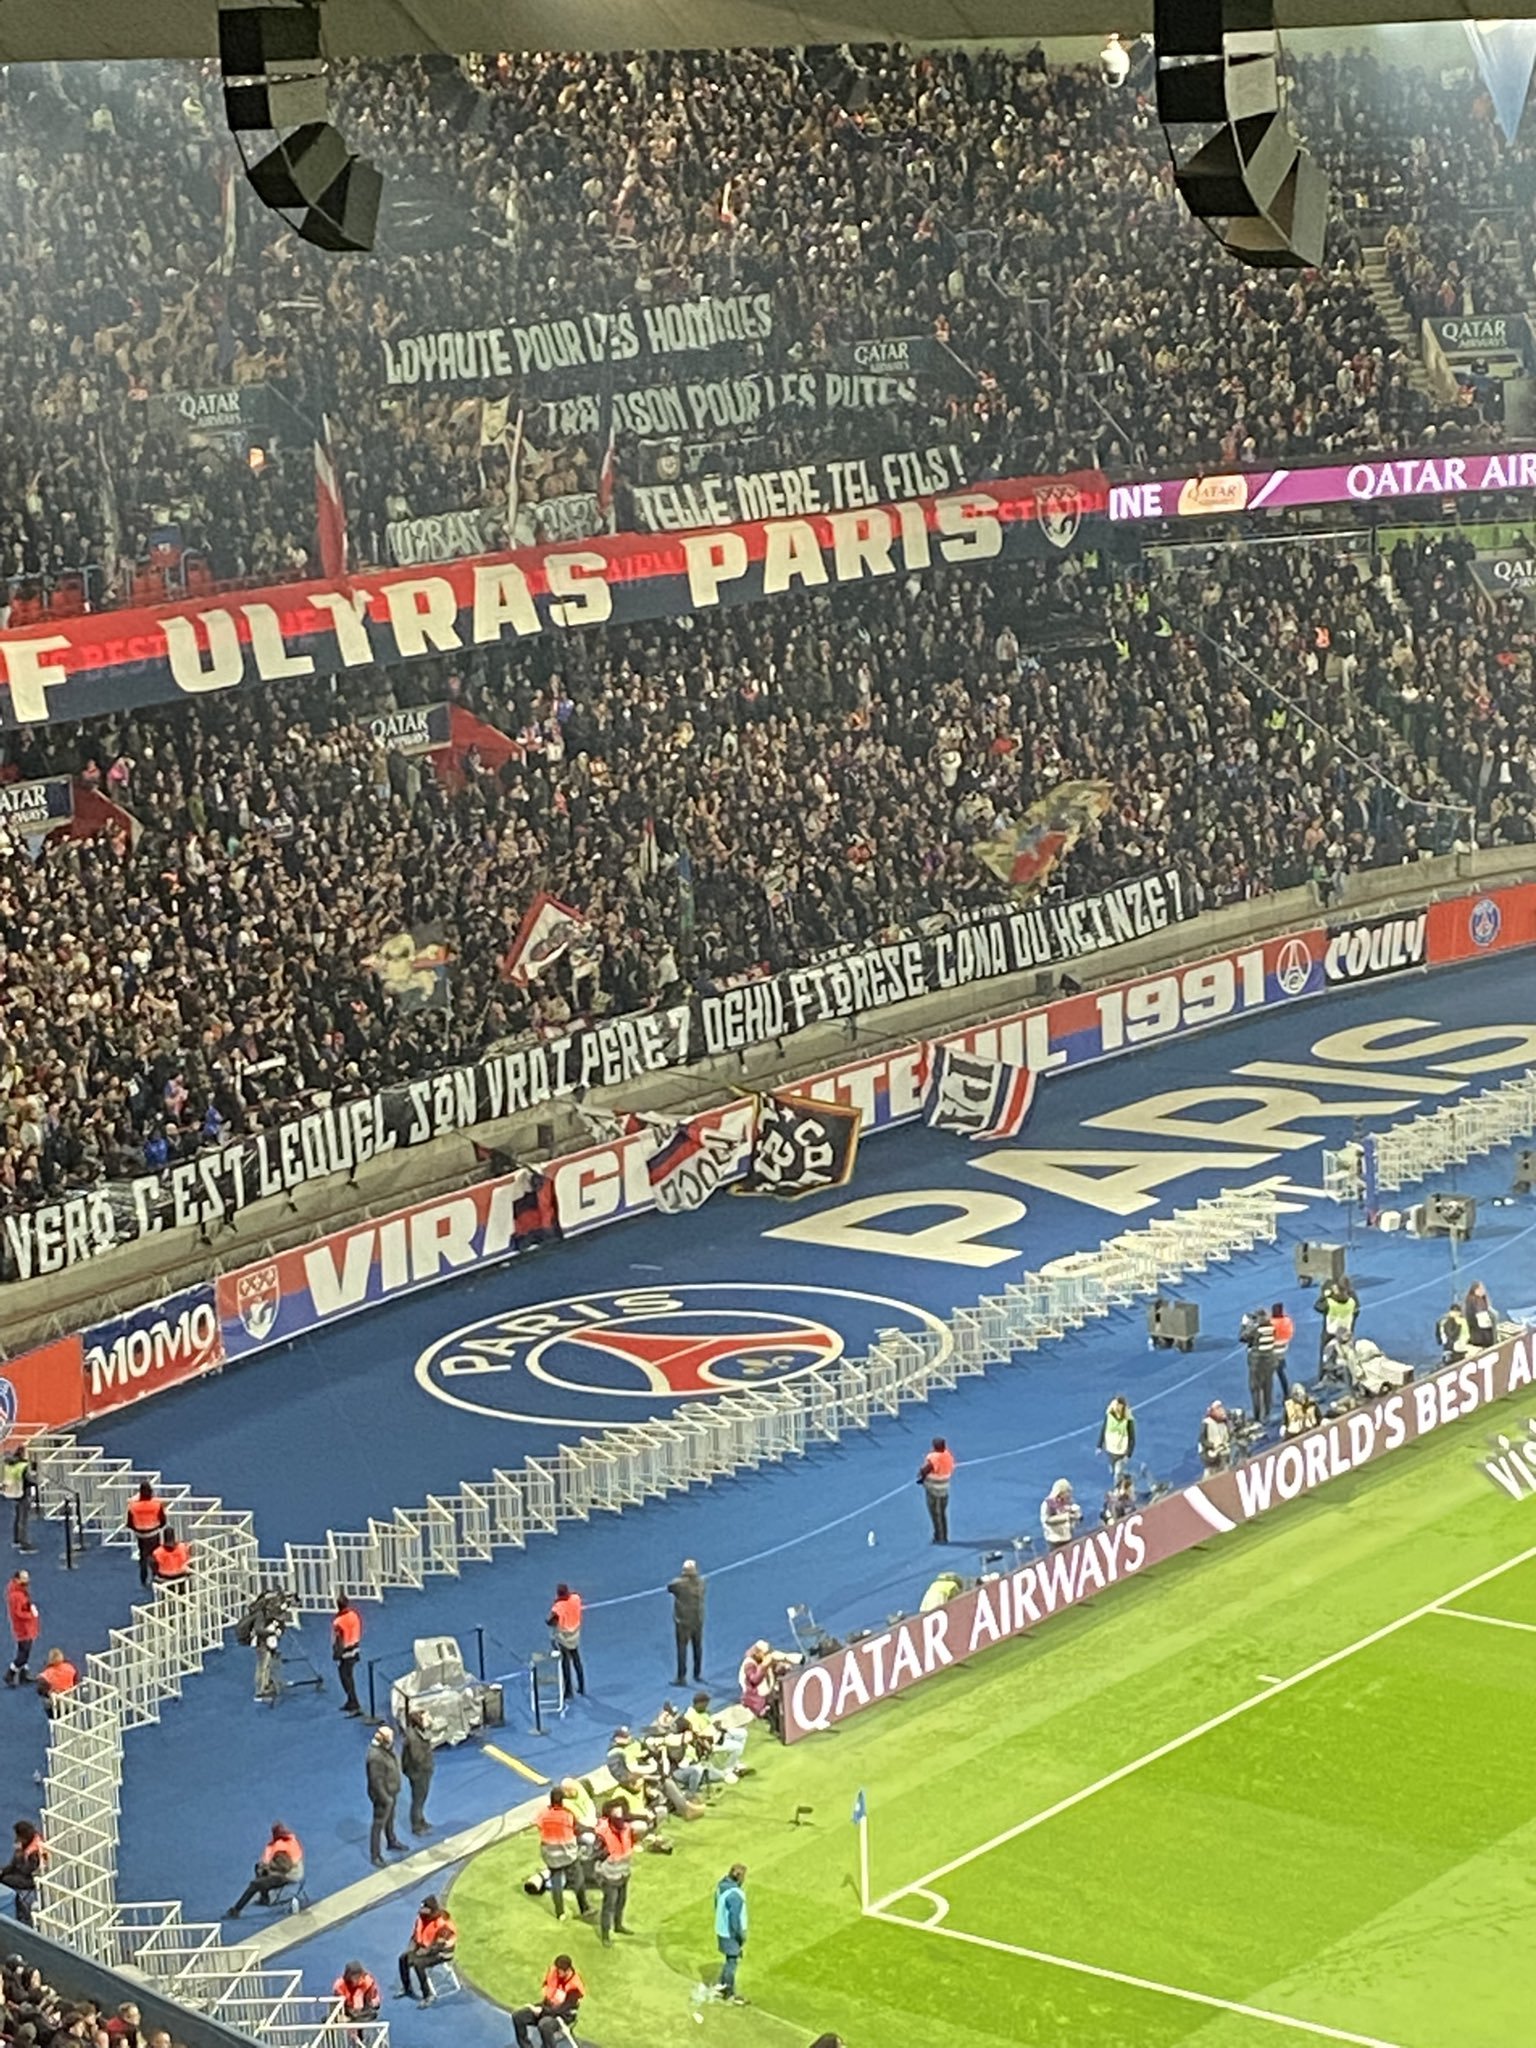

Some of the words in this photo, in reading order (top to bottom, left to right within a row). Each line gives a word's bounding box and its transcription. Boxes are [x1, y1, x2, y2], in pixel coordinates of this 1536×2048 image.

[381, 327, 513, 384] LOYAUTE
[512, 320, 587, 374] POUR
[643, 293, 772, 354] HOMMES
[854, 342, 909, 365] QATAR
[1442, 320, 1506, 342] QATAR
[180, 391, 241, 420] QATAR
[686, 376, 764, 430] POUR
[634, 477, 732, 531] TELLE
[826, 459, 879, 509] TEL
[882, 447, 949, 501] FILS
[1346, 459, 1468, 500] QATAR
[680, 493, 1003, 608] PARIS
[370, 711, 429, 742] QATAR
[256, 1093, 398, 1197] LEQUEL
[409, 1066, 478, 1144] SON
[486, 1037, 574, 1120] VRAI
[580, 1013, 669, 1088] PERE
[935, 921, 1010, 989] CANA
[1052, 875, 1169, 959] HEINZE
[1096, 949, 1265, 1051] 1991
[762, 1017, 1536, 1268] PARIS
[84, 1303, 217, 1396] MOMO
[441, 1292, 685, 1377] PARIS
[791, 1609, 953, 1731] QATAR
[969, 1514, 1145, 1652] AIRWAYS
[1235, 1395, 1406, 1518] WORLD'S
[1413, 1351, 1500, 1434] BEST
